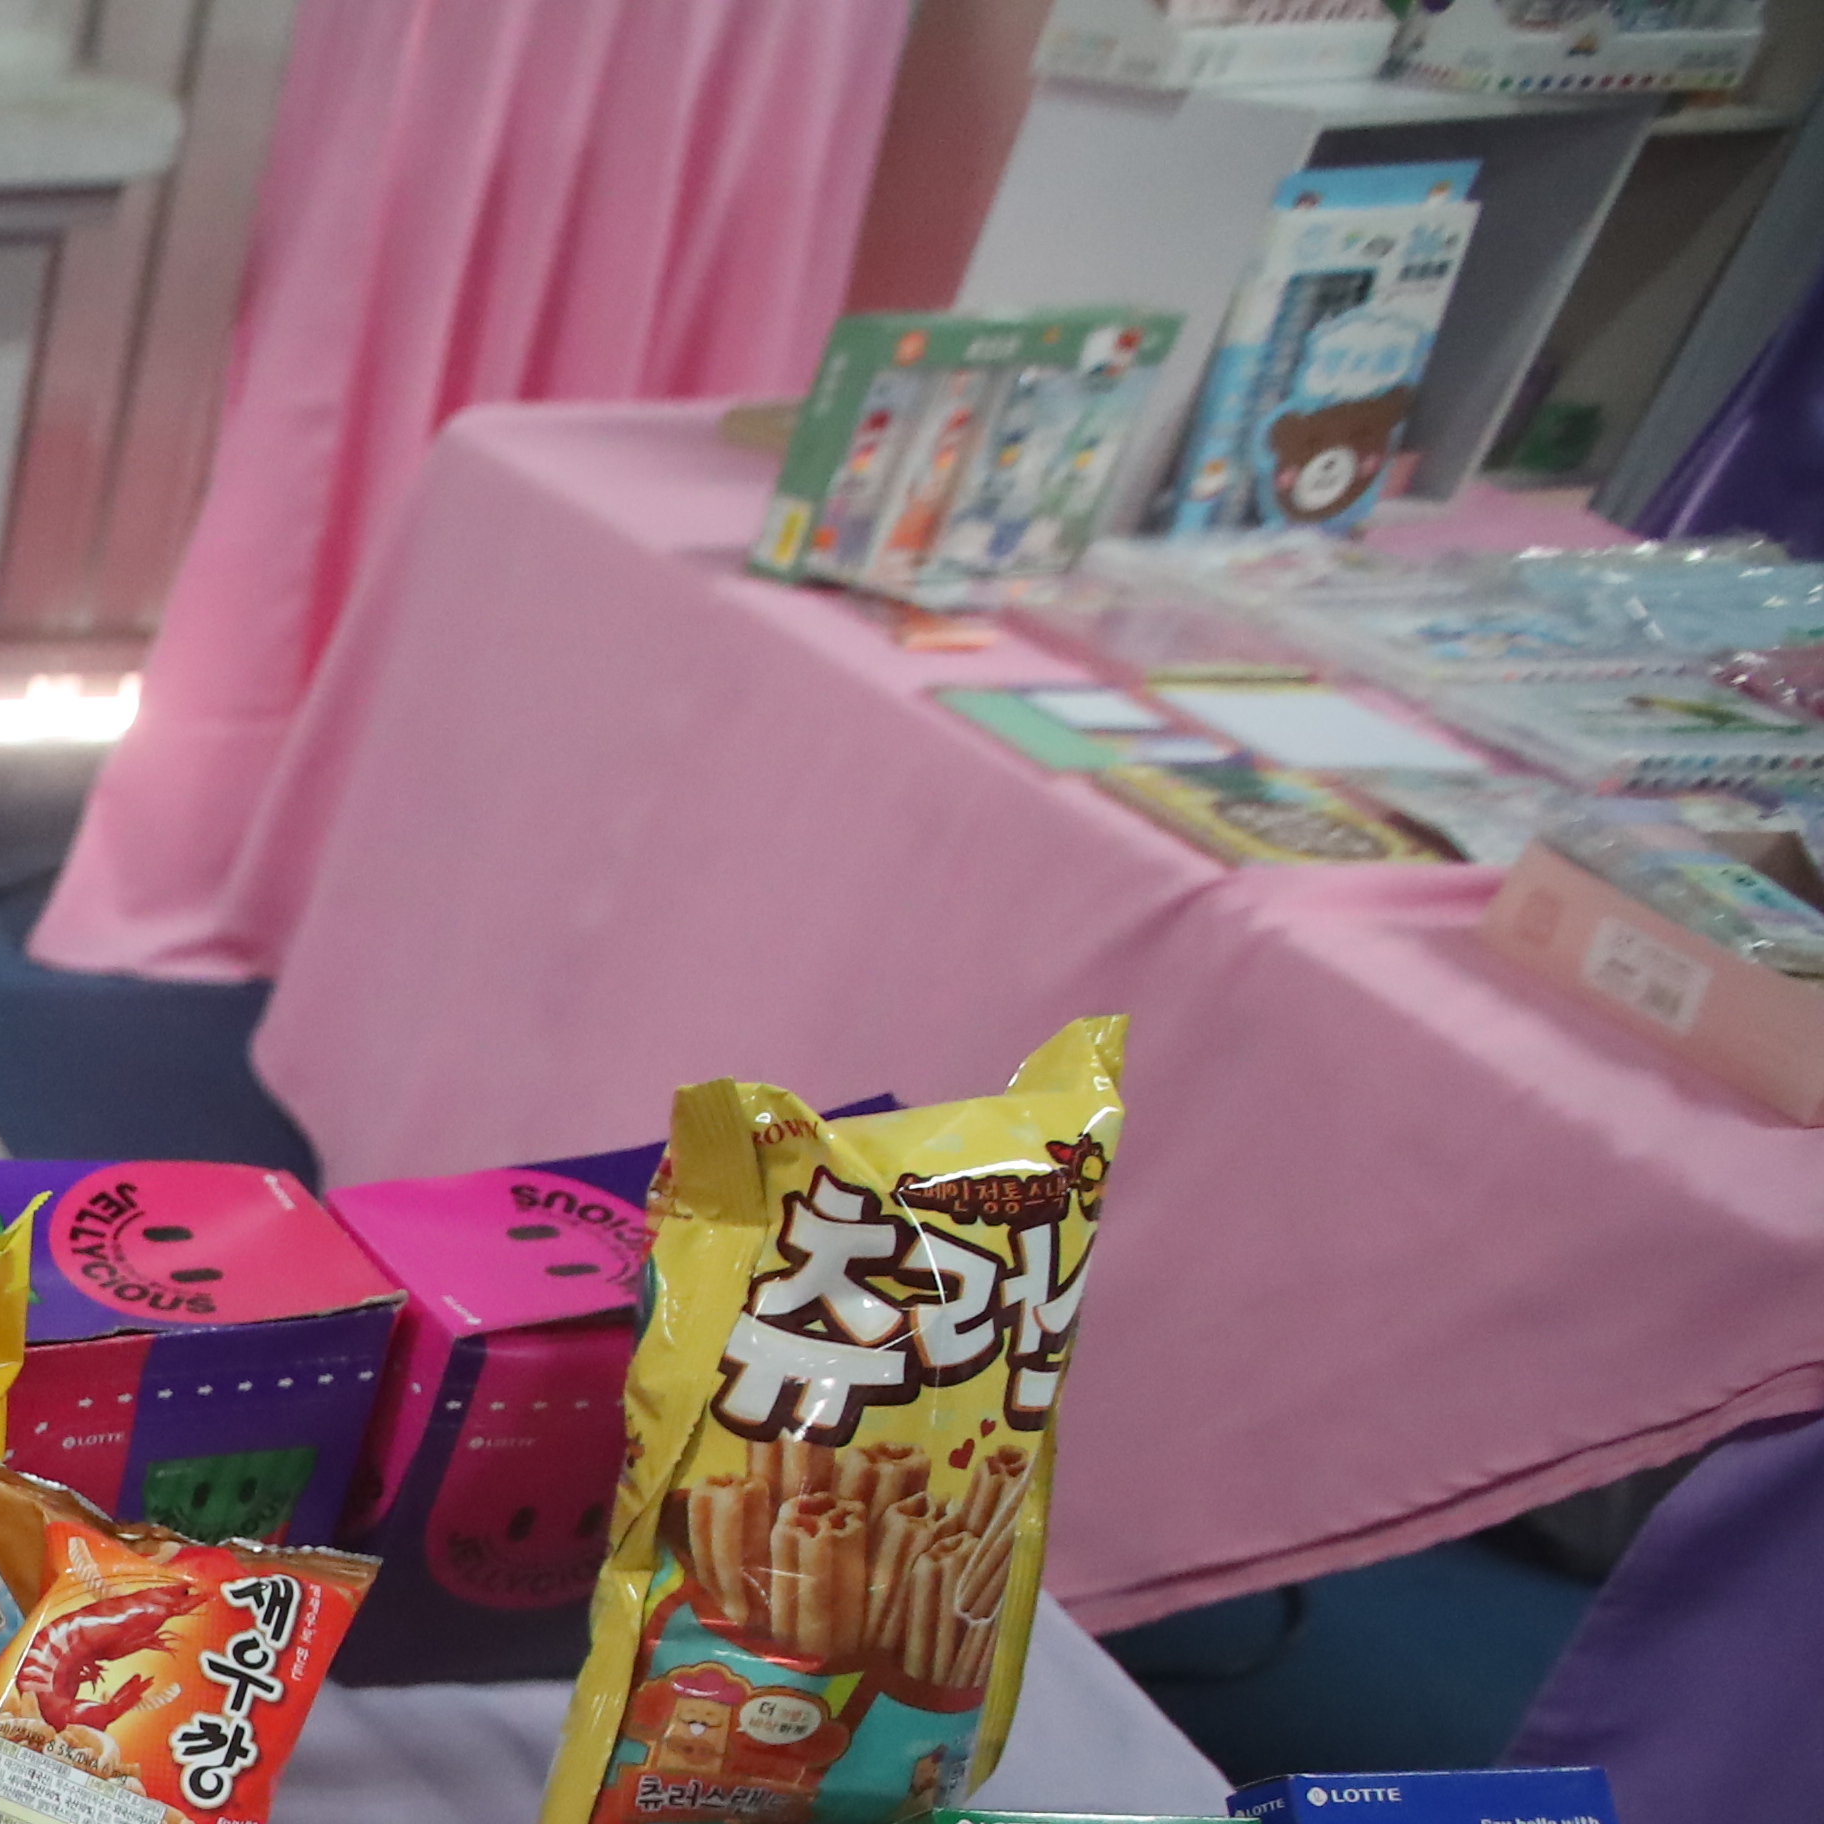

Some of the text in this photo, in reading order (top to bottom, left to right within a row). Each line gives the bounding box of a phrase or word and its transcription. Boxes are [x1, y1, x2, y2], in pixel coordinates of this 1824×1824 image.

[67, 1181, 219, 1316] JELLYCIOUS
[76, 1432, 126, 1447] LOTTE
[169, 1573, 303, 1809] 새우깡
[1331, 1787, 1402, 1803] LOTTE
